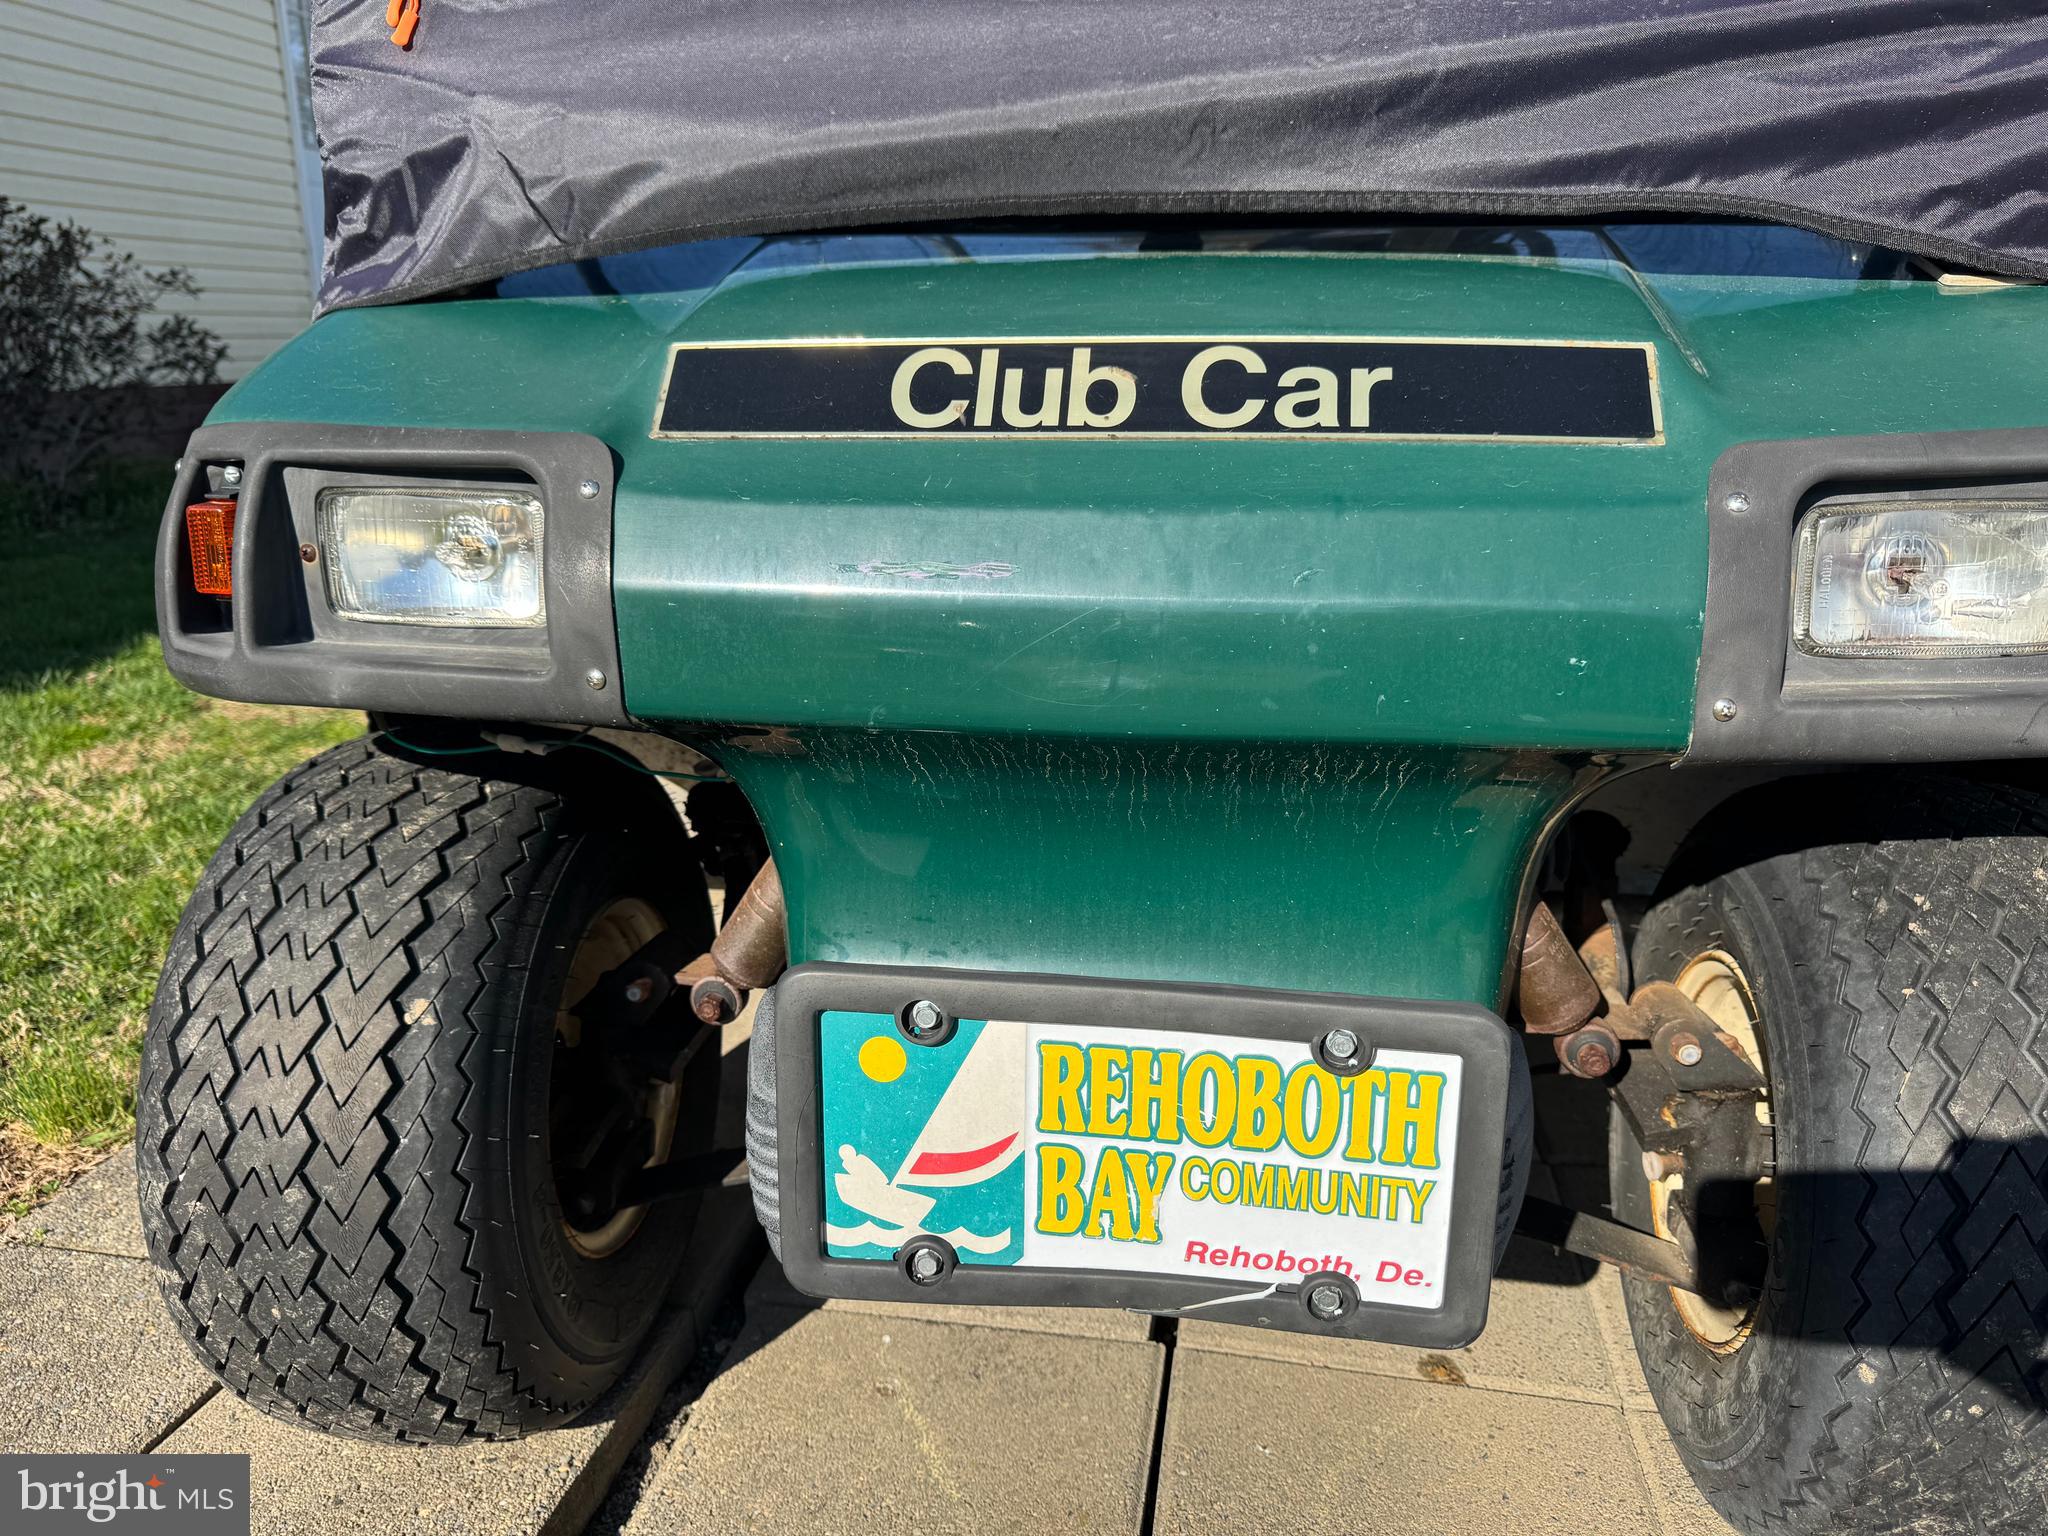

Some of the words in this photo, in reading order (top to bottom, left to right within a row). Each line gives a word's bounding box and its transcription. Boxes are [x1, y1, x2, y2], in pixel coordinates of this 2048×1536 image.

[890, 346, 1137, 430] Club
[1181, 345, 1394, 430] Car
[1036, 1040, 1448, 1170] REHOBOTH
[1035, 1142, 1177, 1245] BAY
[1180, 1155, 1435, 1224] COMMUNITY
[1184, 1240, 1361, 1282] Rehoboth,
[1375, 1260, 1433, 1288] De.
